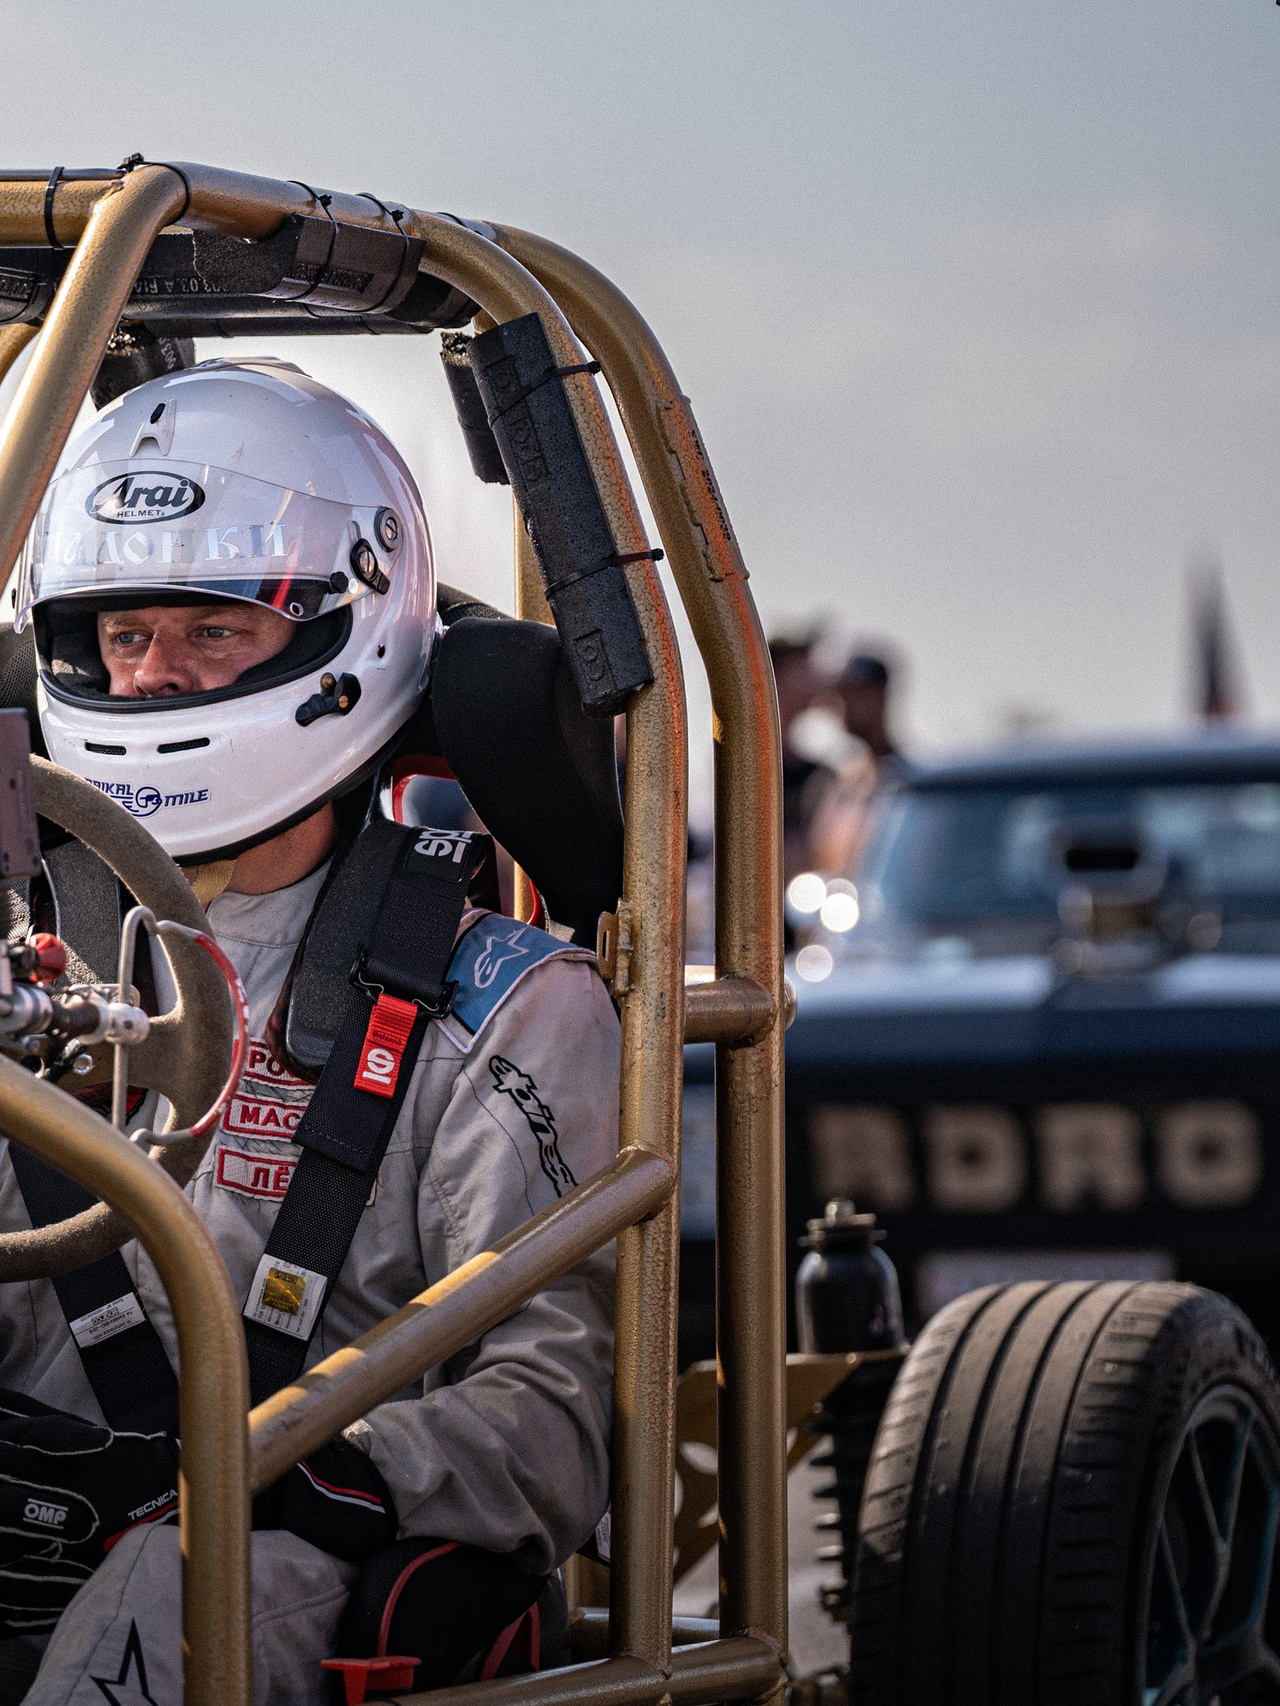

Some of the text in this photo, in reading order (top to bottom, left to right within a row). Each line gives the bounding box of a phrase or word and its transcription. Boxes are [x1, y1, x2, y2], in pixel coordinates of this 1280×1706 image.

[91, 477, 189, 512] Arai
[117, 509, 161, 518] HELMET
[164, 789, 208, 807] MILE
[24, 1503, 67, 1525] OMP
[128, 1489, 178, 1521] TECNICA
